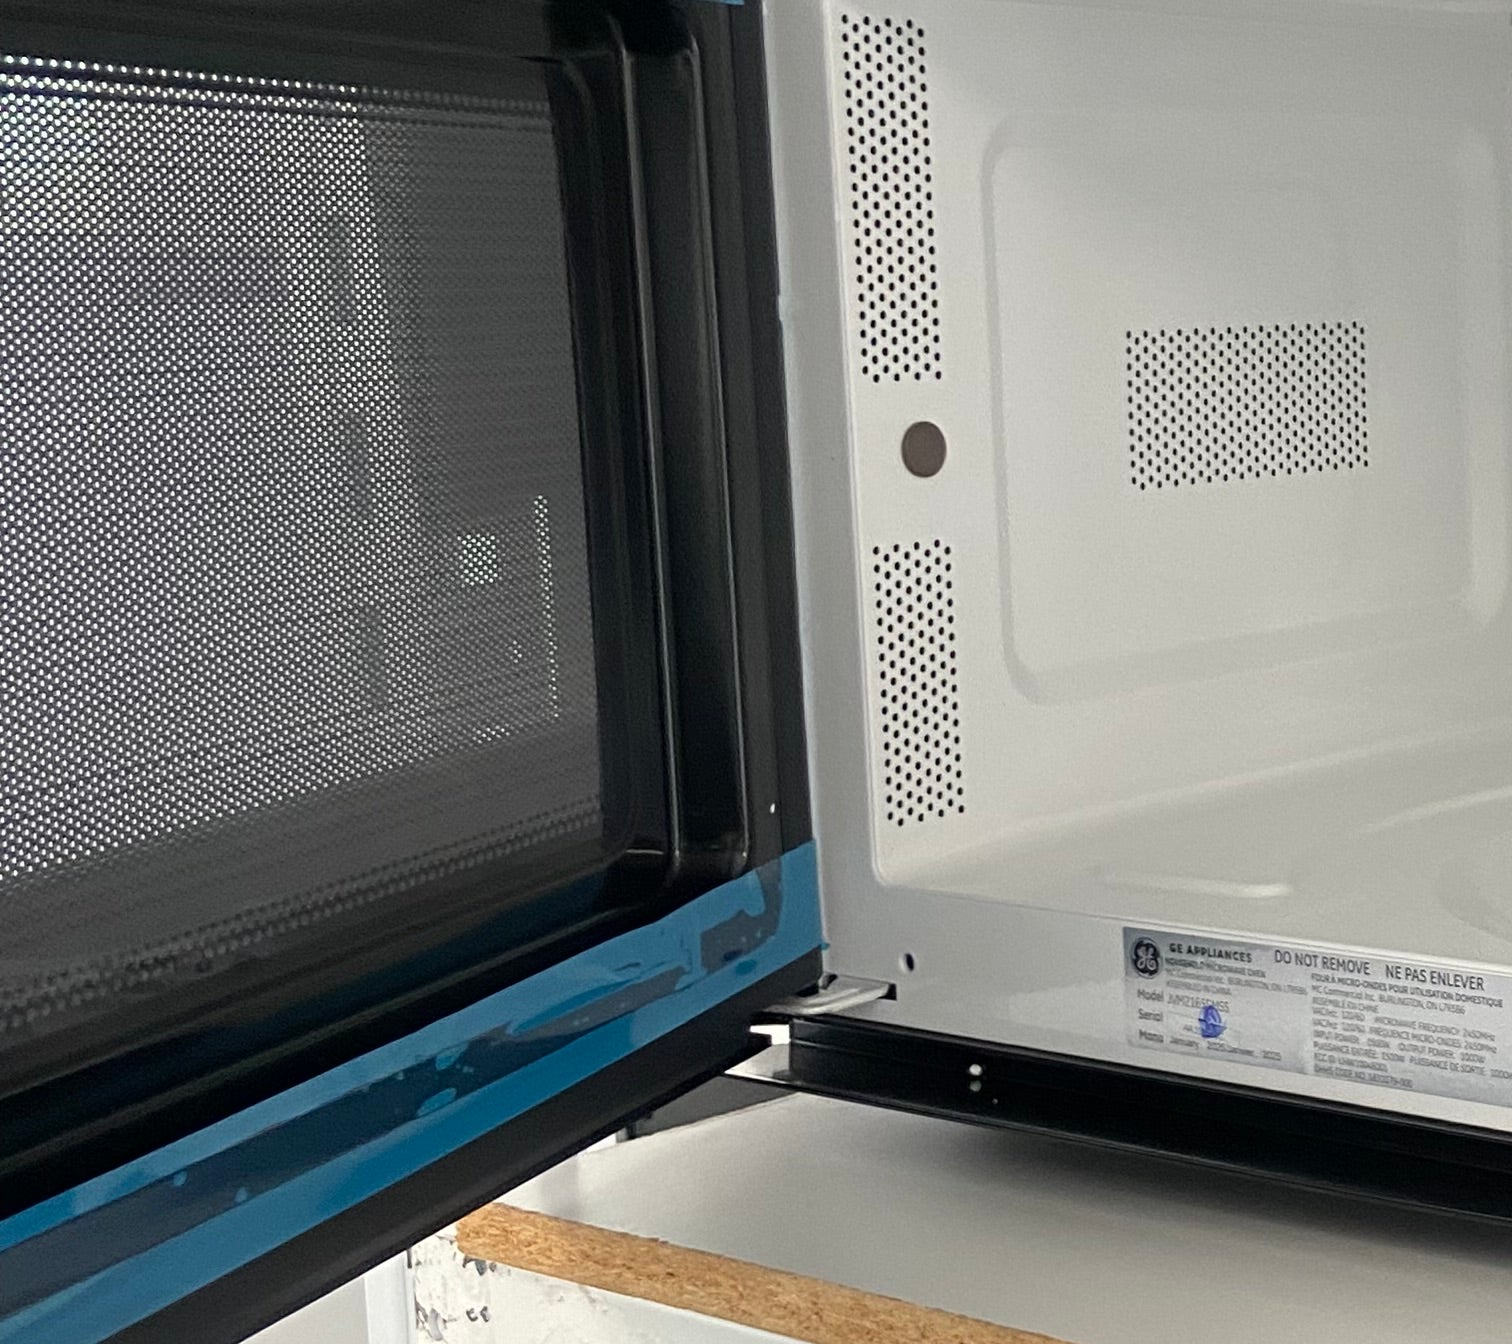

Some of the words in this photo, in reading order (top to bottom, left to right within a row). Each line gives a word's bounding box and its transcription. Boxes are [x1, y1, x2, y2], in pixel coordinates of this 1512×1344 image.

[1169, 942, 1184, 954] GE
[1187, 945, 1253, 963] APPLIANCES
[1274, 949, 1292, 964] DO
[1294, 952, 1319, 968] NOT
[1322, 955, 1371, 975] REMOVE
[1386, 964, 1402, 980] NE
[1405, 966, 1427, 983] PAS
[1430, 970, 1485, 991] ENLEVER
[1137, 989, 1164, 1002] Model
[1138, 1008, 1163, 1022] Serial
